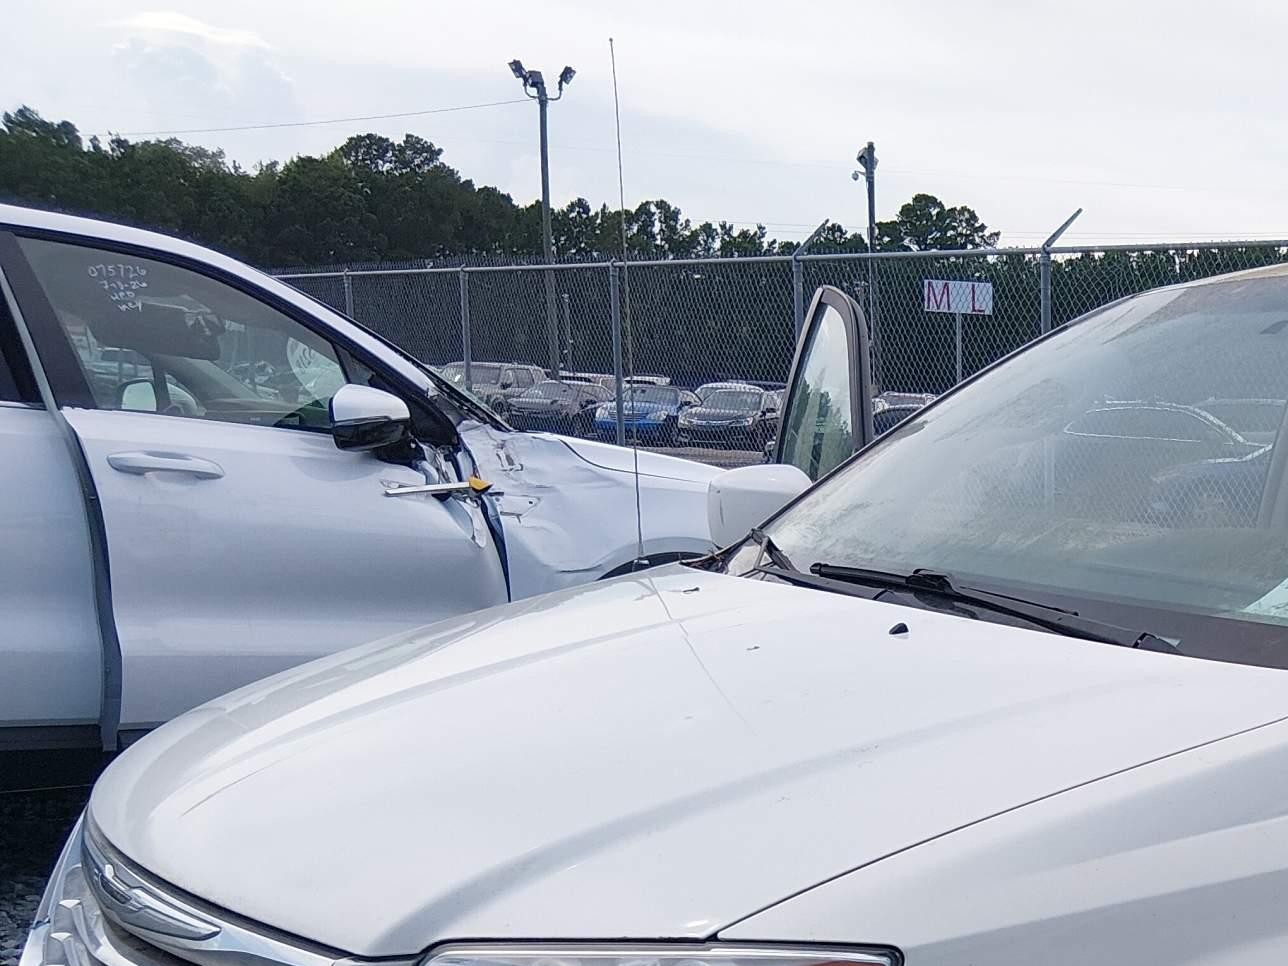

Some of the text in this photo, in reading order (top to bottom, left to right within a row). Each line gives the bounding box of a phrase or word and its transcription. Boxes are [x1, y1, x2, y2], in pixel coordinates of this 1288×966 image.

[88, 264, 147, 279] 075726
[926, 280, 986, 312] M L
